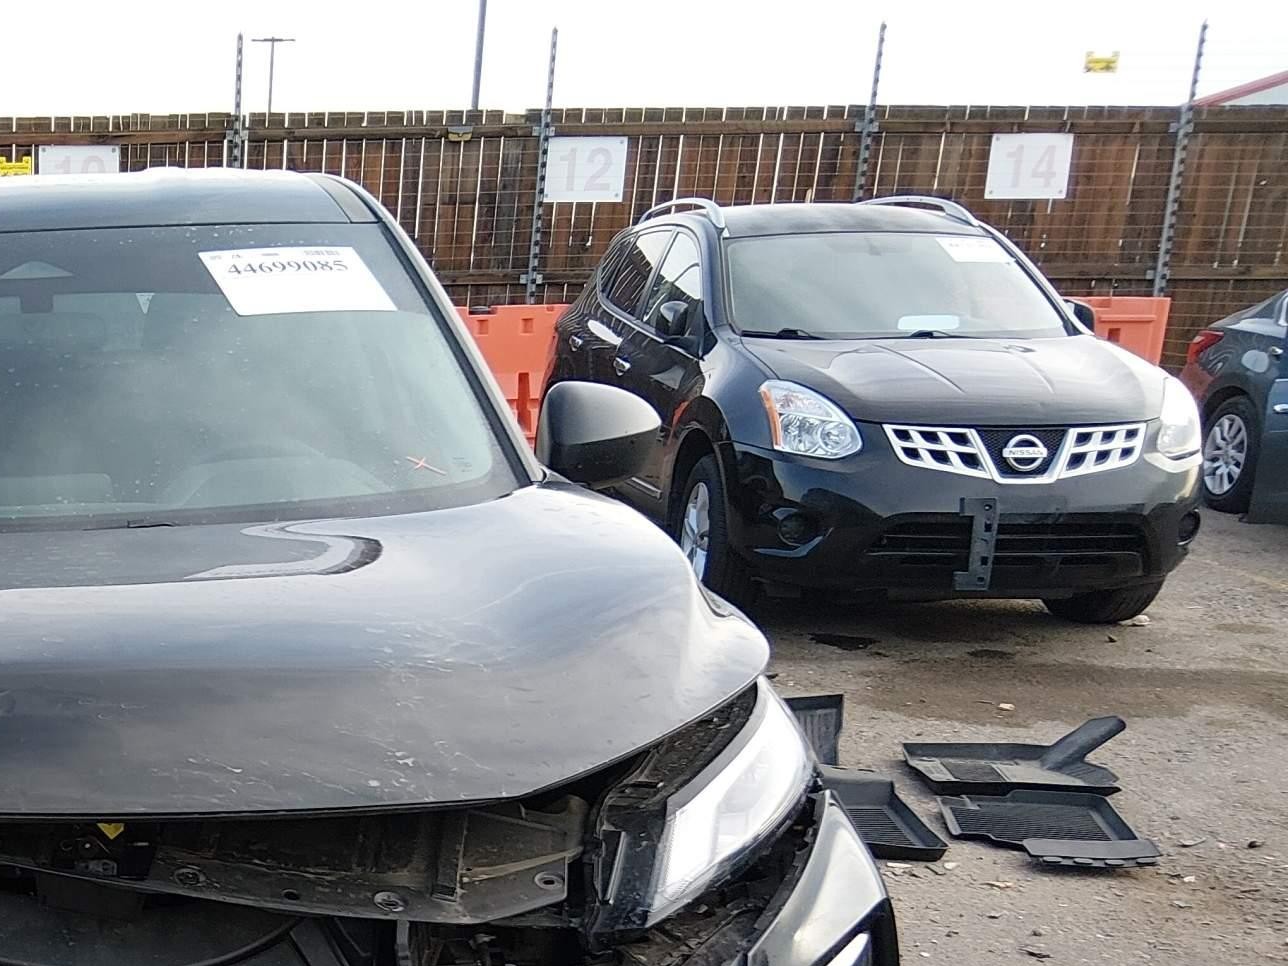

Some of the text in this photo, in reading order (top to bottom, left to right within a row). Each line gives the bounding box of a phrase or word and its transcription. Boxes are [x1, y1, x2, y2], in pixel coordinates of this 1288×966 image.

[559, 146, 615, 192] 12
[1005, 143, 1057, 189] 14
[227, 259, 349, 275] 44699085
